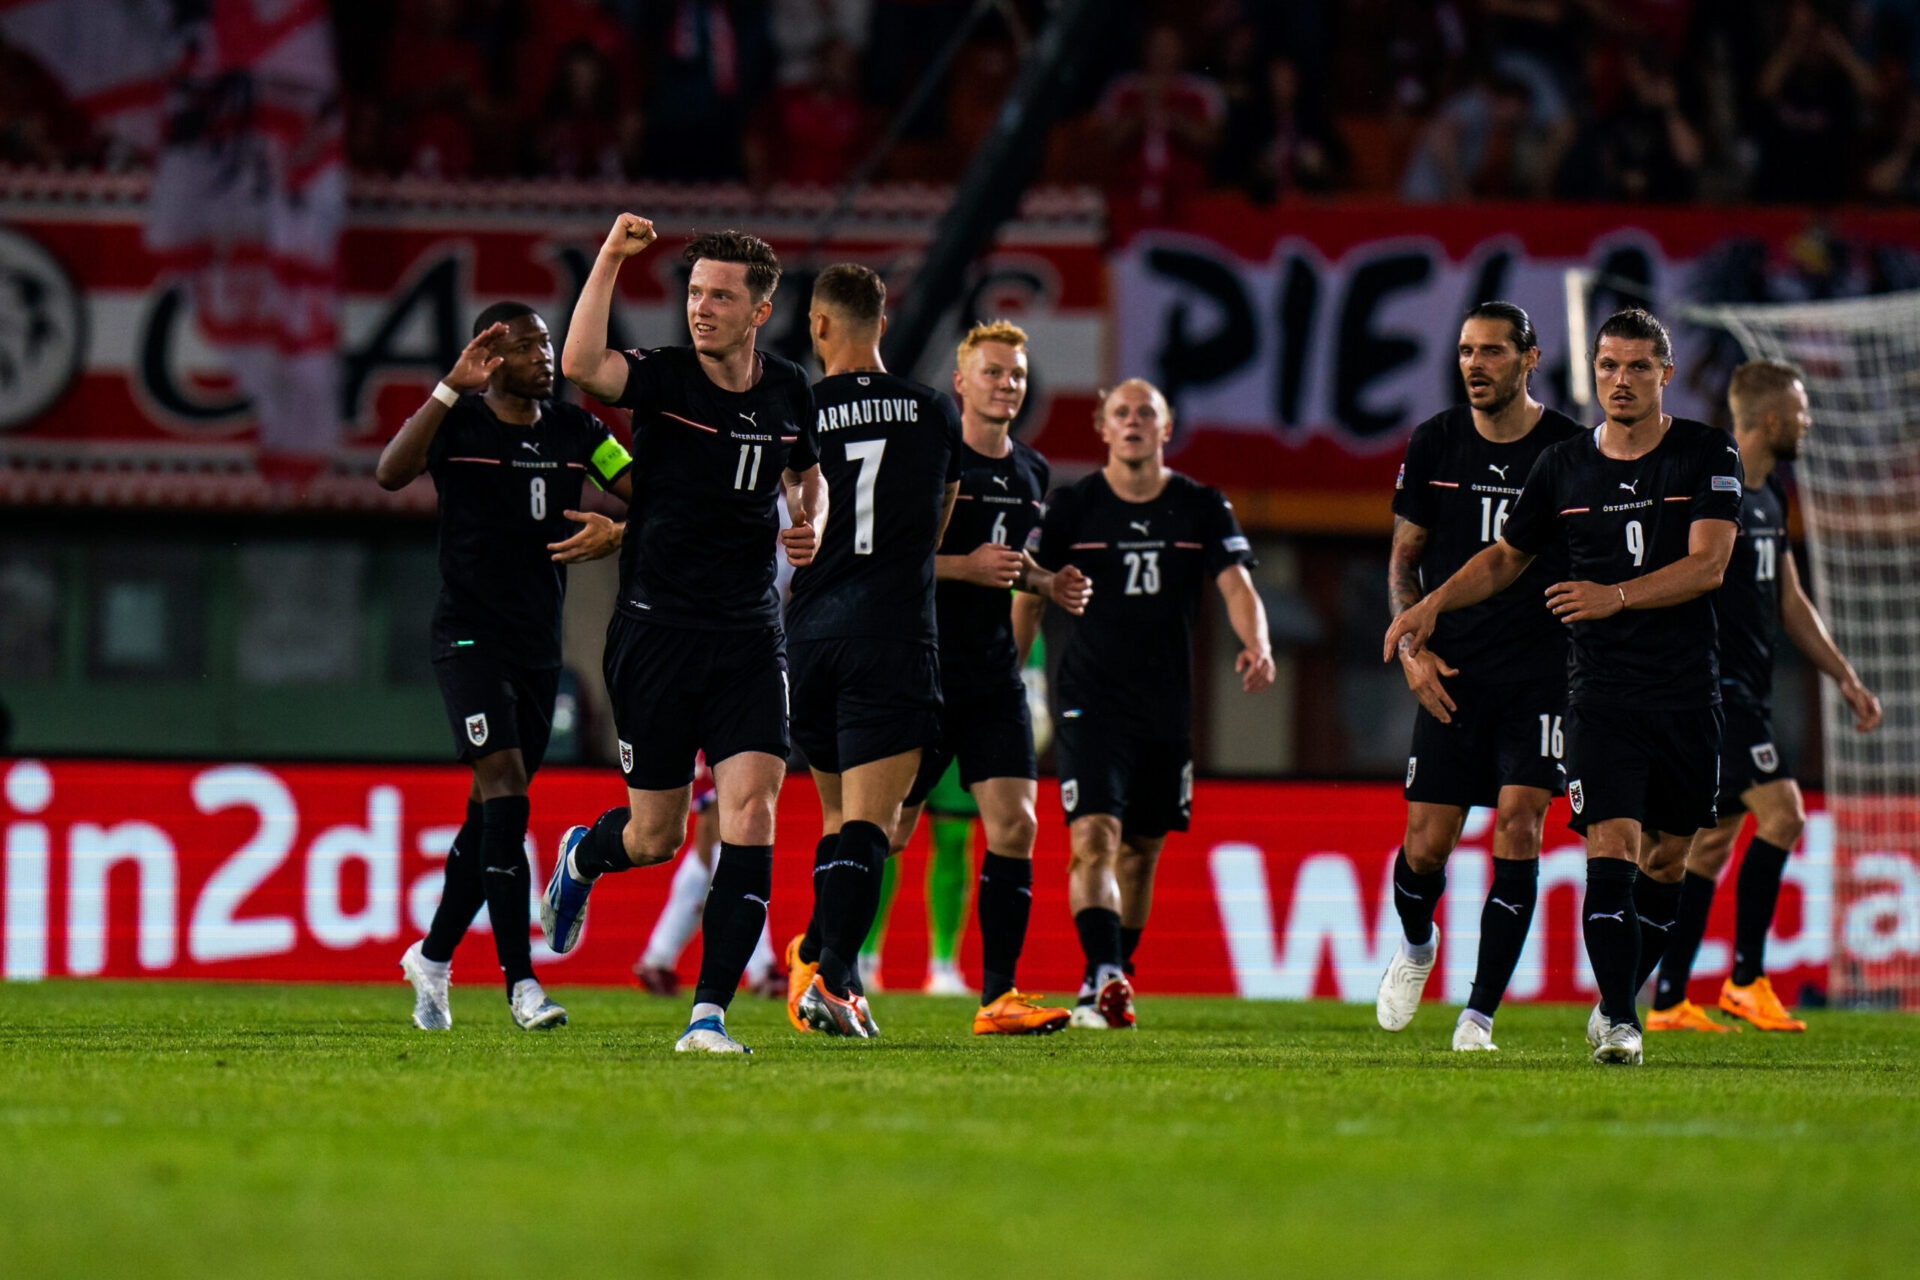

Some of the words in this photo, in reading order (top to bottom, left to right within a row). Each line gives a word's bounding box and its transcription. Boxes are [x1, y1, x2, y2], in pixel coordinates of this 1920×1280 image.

[817, 399, 918, 433] ARNAUTOVIC
[734, 444, 762, 491] 11
[530, 476, 546, 520] 8
[844, 438, 887, 555] 7
[1602, 499, 1653, 512] ÖSTERREICH
[992, 512, 1007, 546] 6
[1481, 497, 1509, 542] 16
[1625, 520, 1645, 567] 9
[1123, 551, 1161, 595] 23
[1538, 713, 1564, 760] 16
